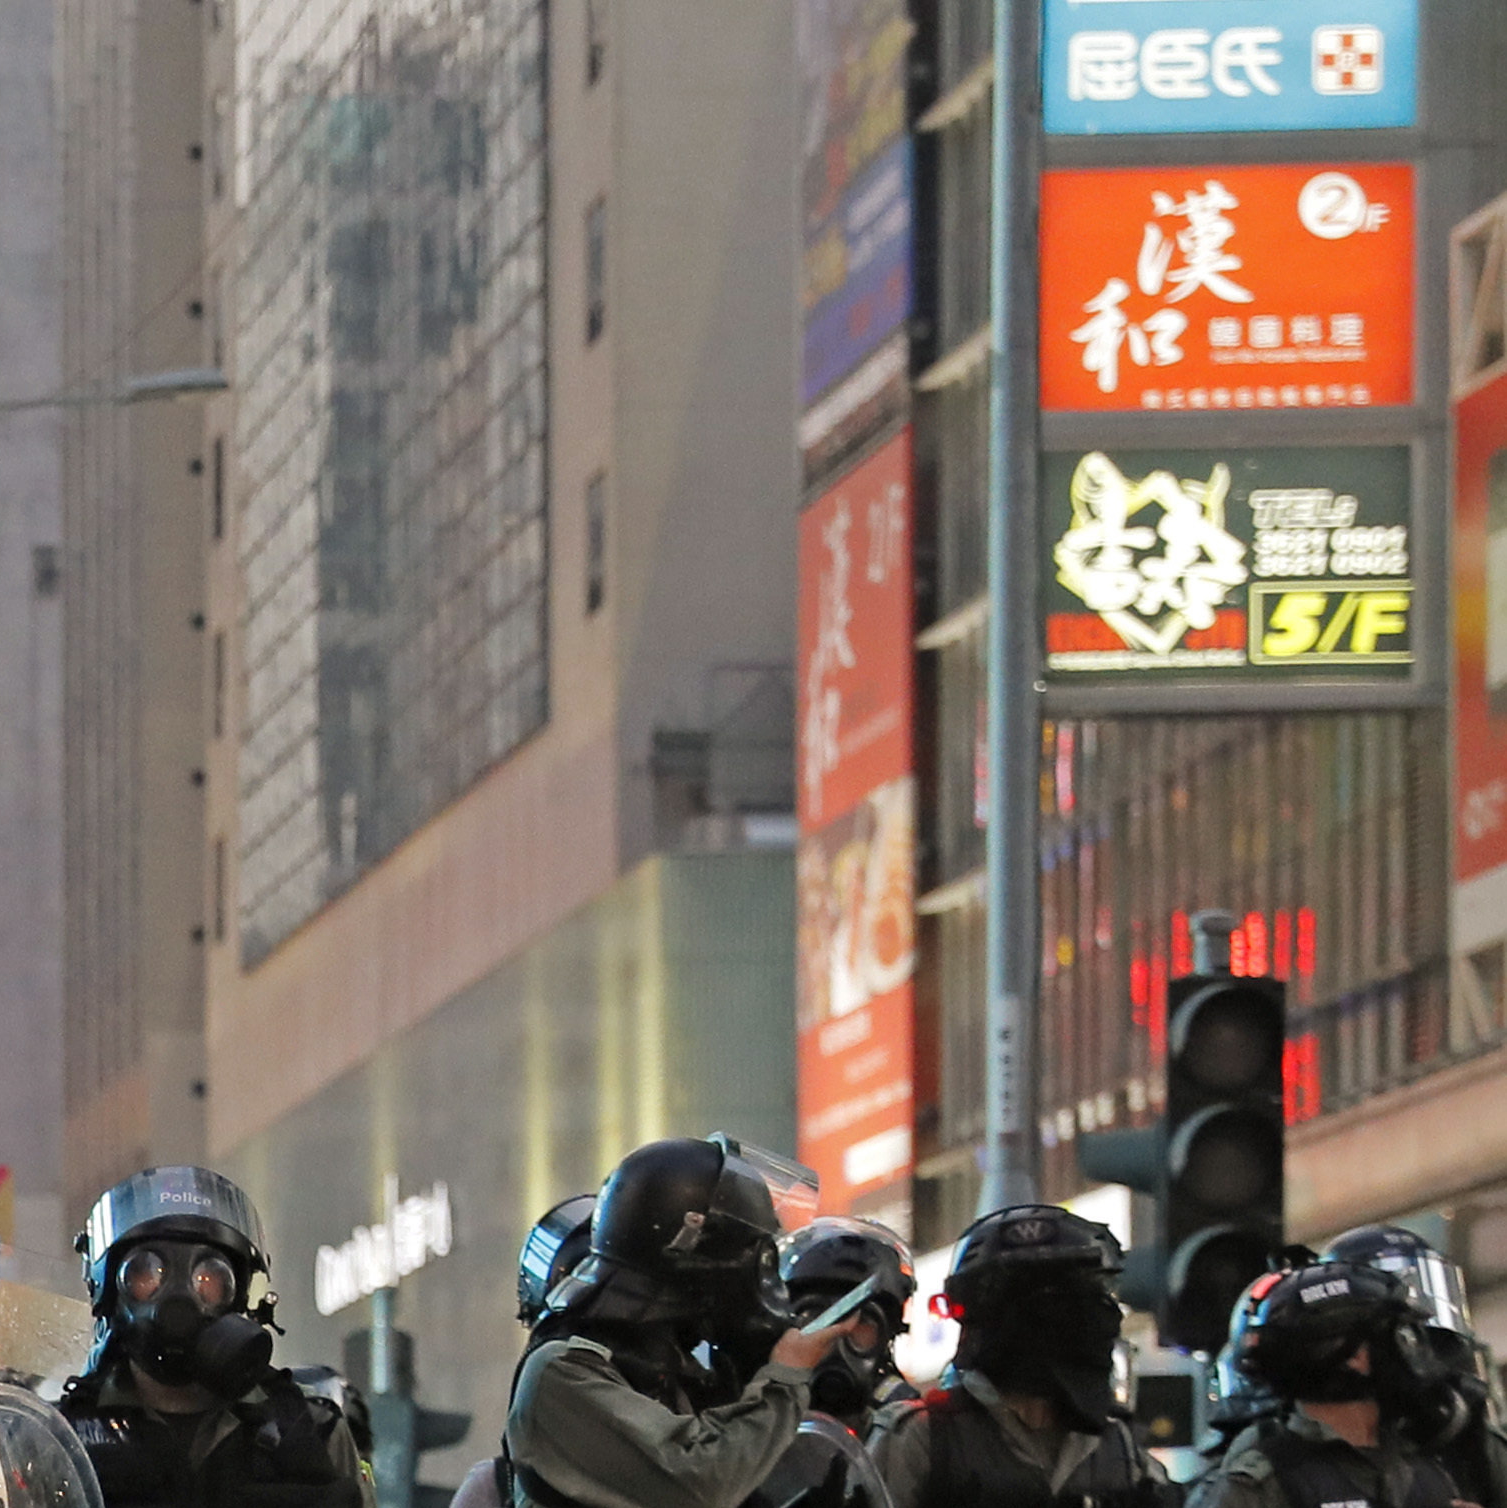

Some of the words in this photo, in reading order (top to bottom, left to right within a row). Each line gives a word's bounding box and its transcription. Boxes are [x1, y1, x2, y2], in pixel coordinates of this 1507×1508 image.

[1067, 26, 1282, 101] 屈臣氏
[1263, 591, 1410, 655] 5/F
